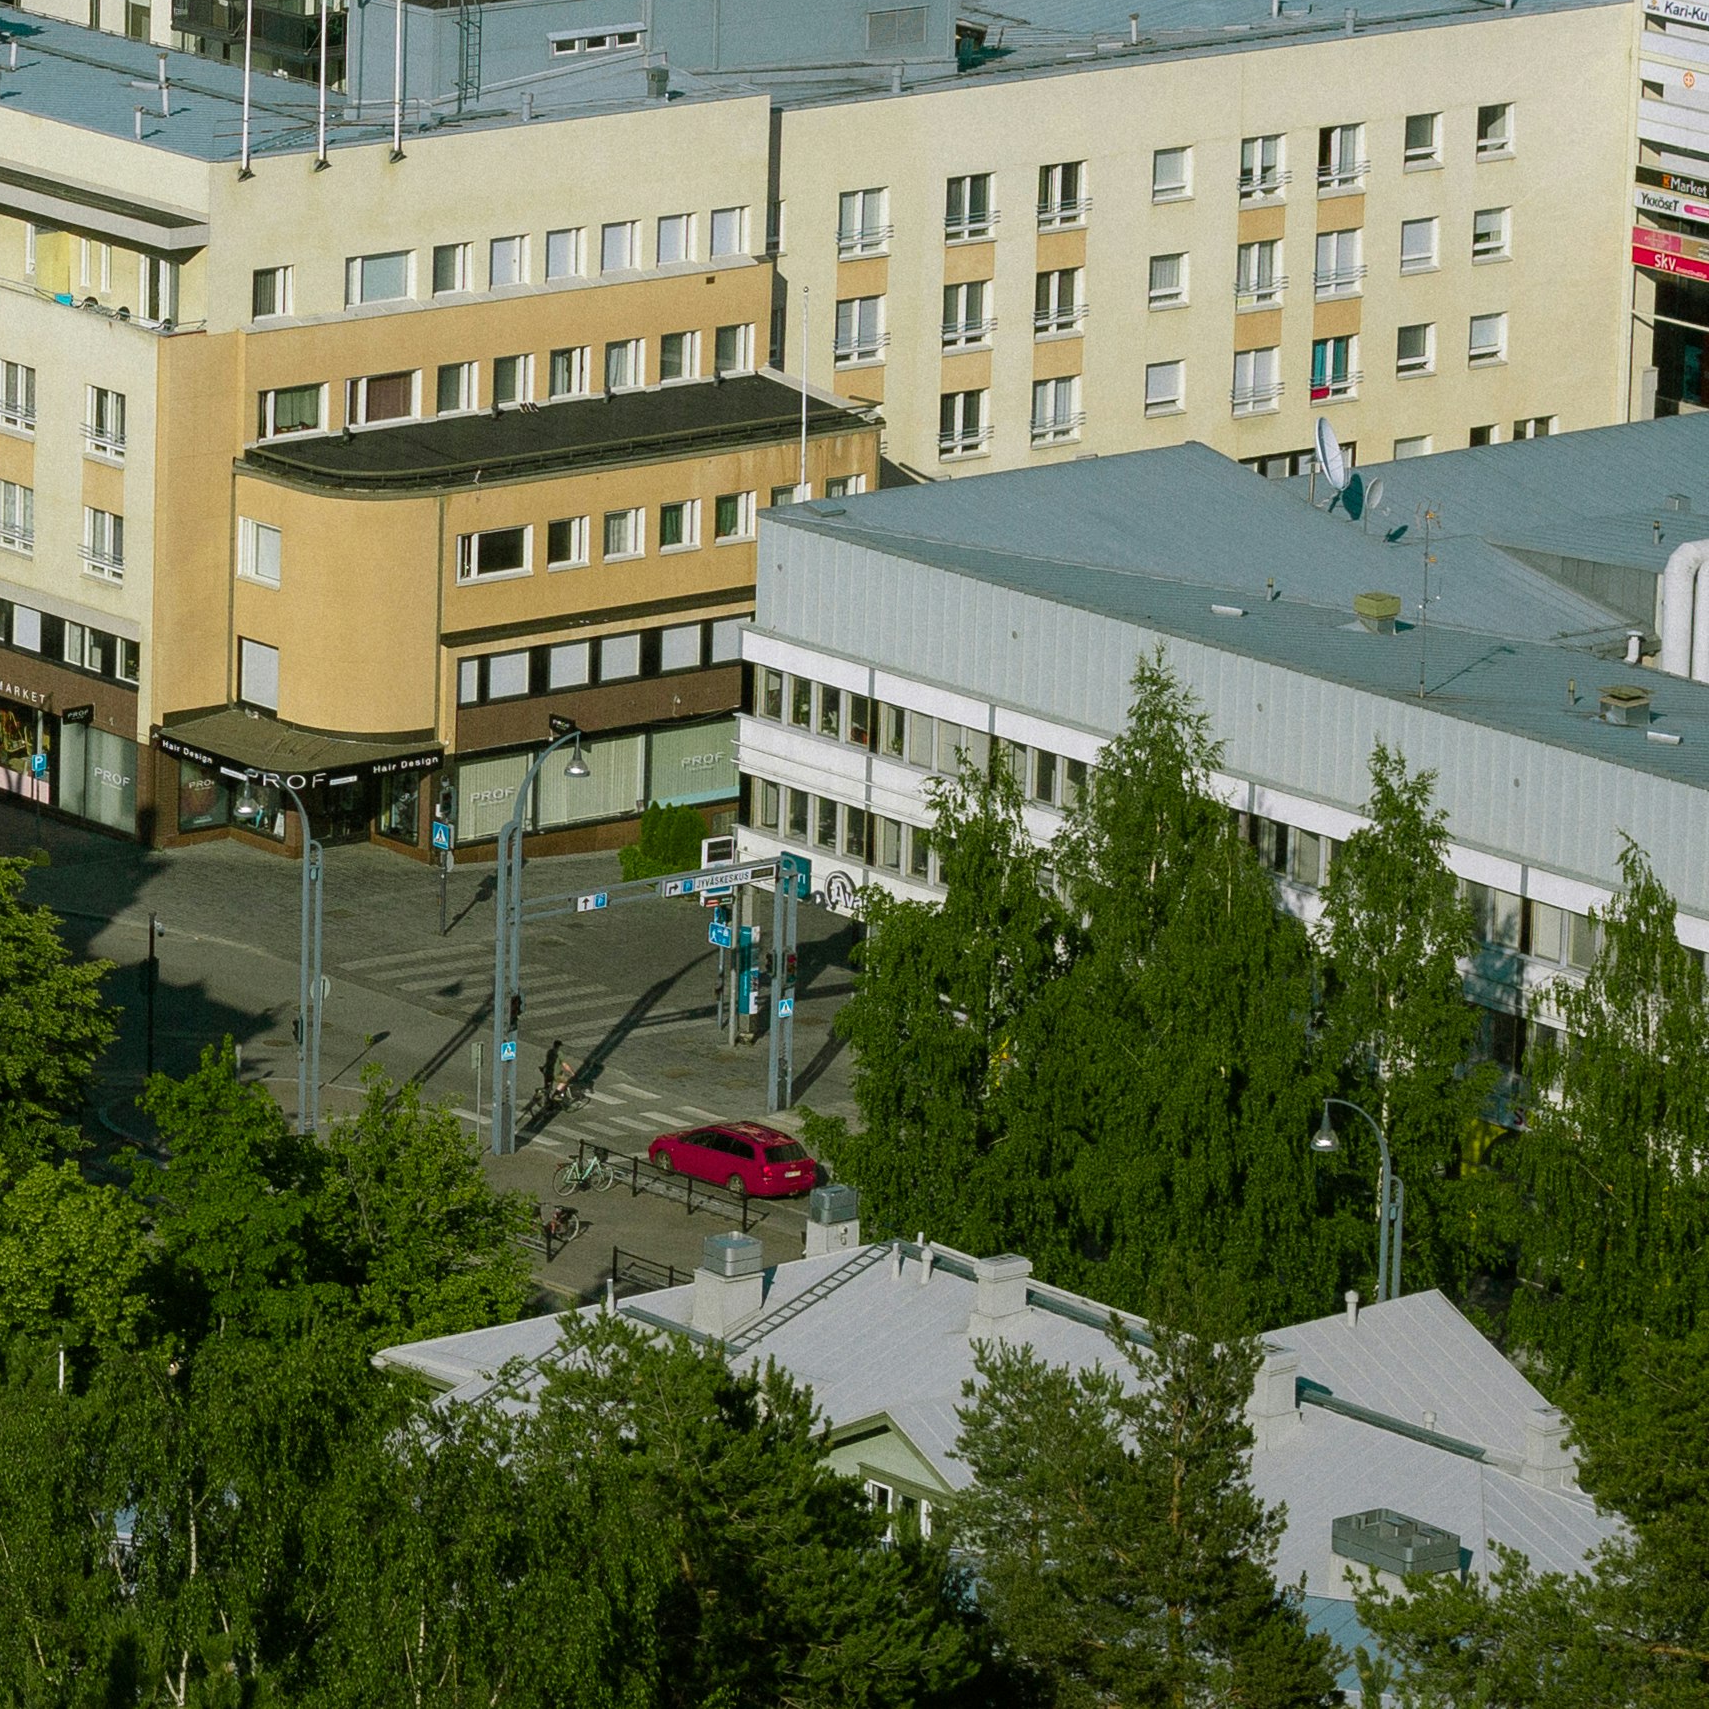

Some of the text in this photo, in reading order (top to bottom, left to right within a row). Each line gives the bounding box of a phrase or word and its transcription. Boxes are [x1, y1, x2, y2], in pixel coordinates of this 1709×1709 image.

[1670, 176, 1708, 198] Market
[162, 739, 214, 764] Hair Design
[681, 751, 727, 768] PROF
[372, 756, 439, 774] Hair Design
[94, 767, 131, 787] PROF
[469, 786, 516, 804] PROF
